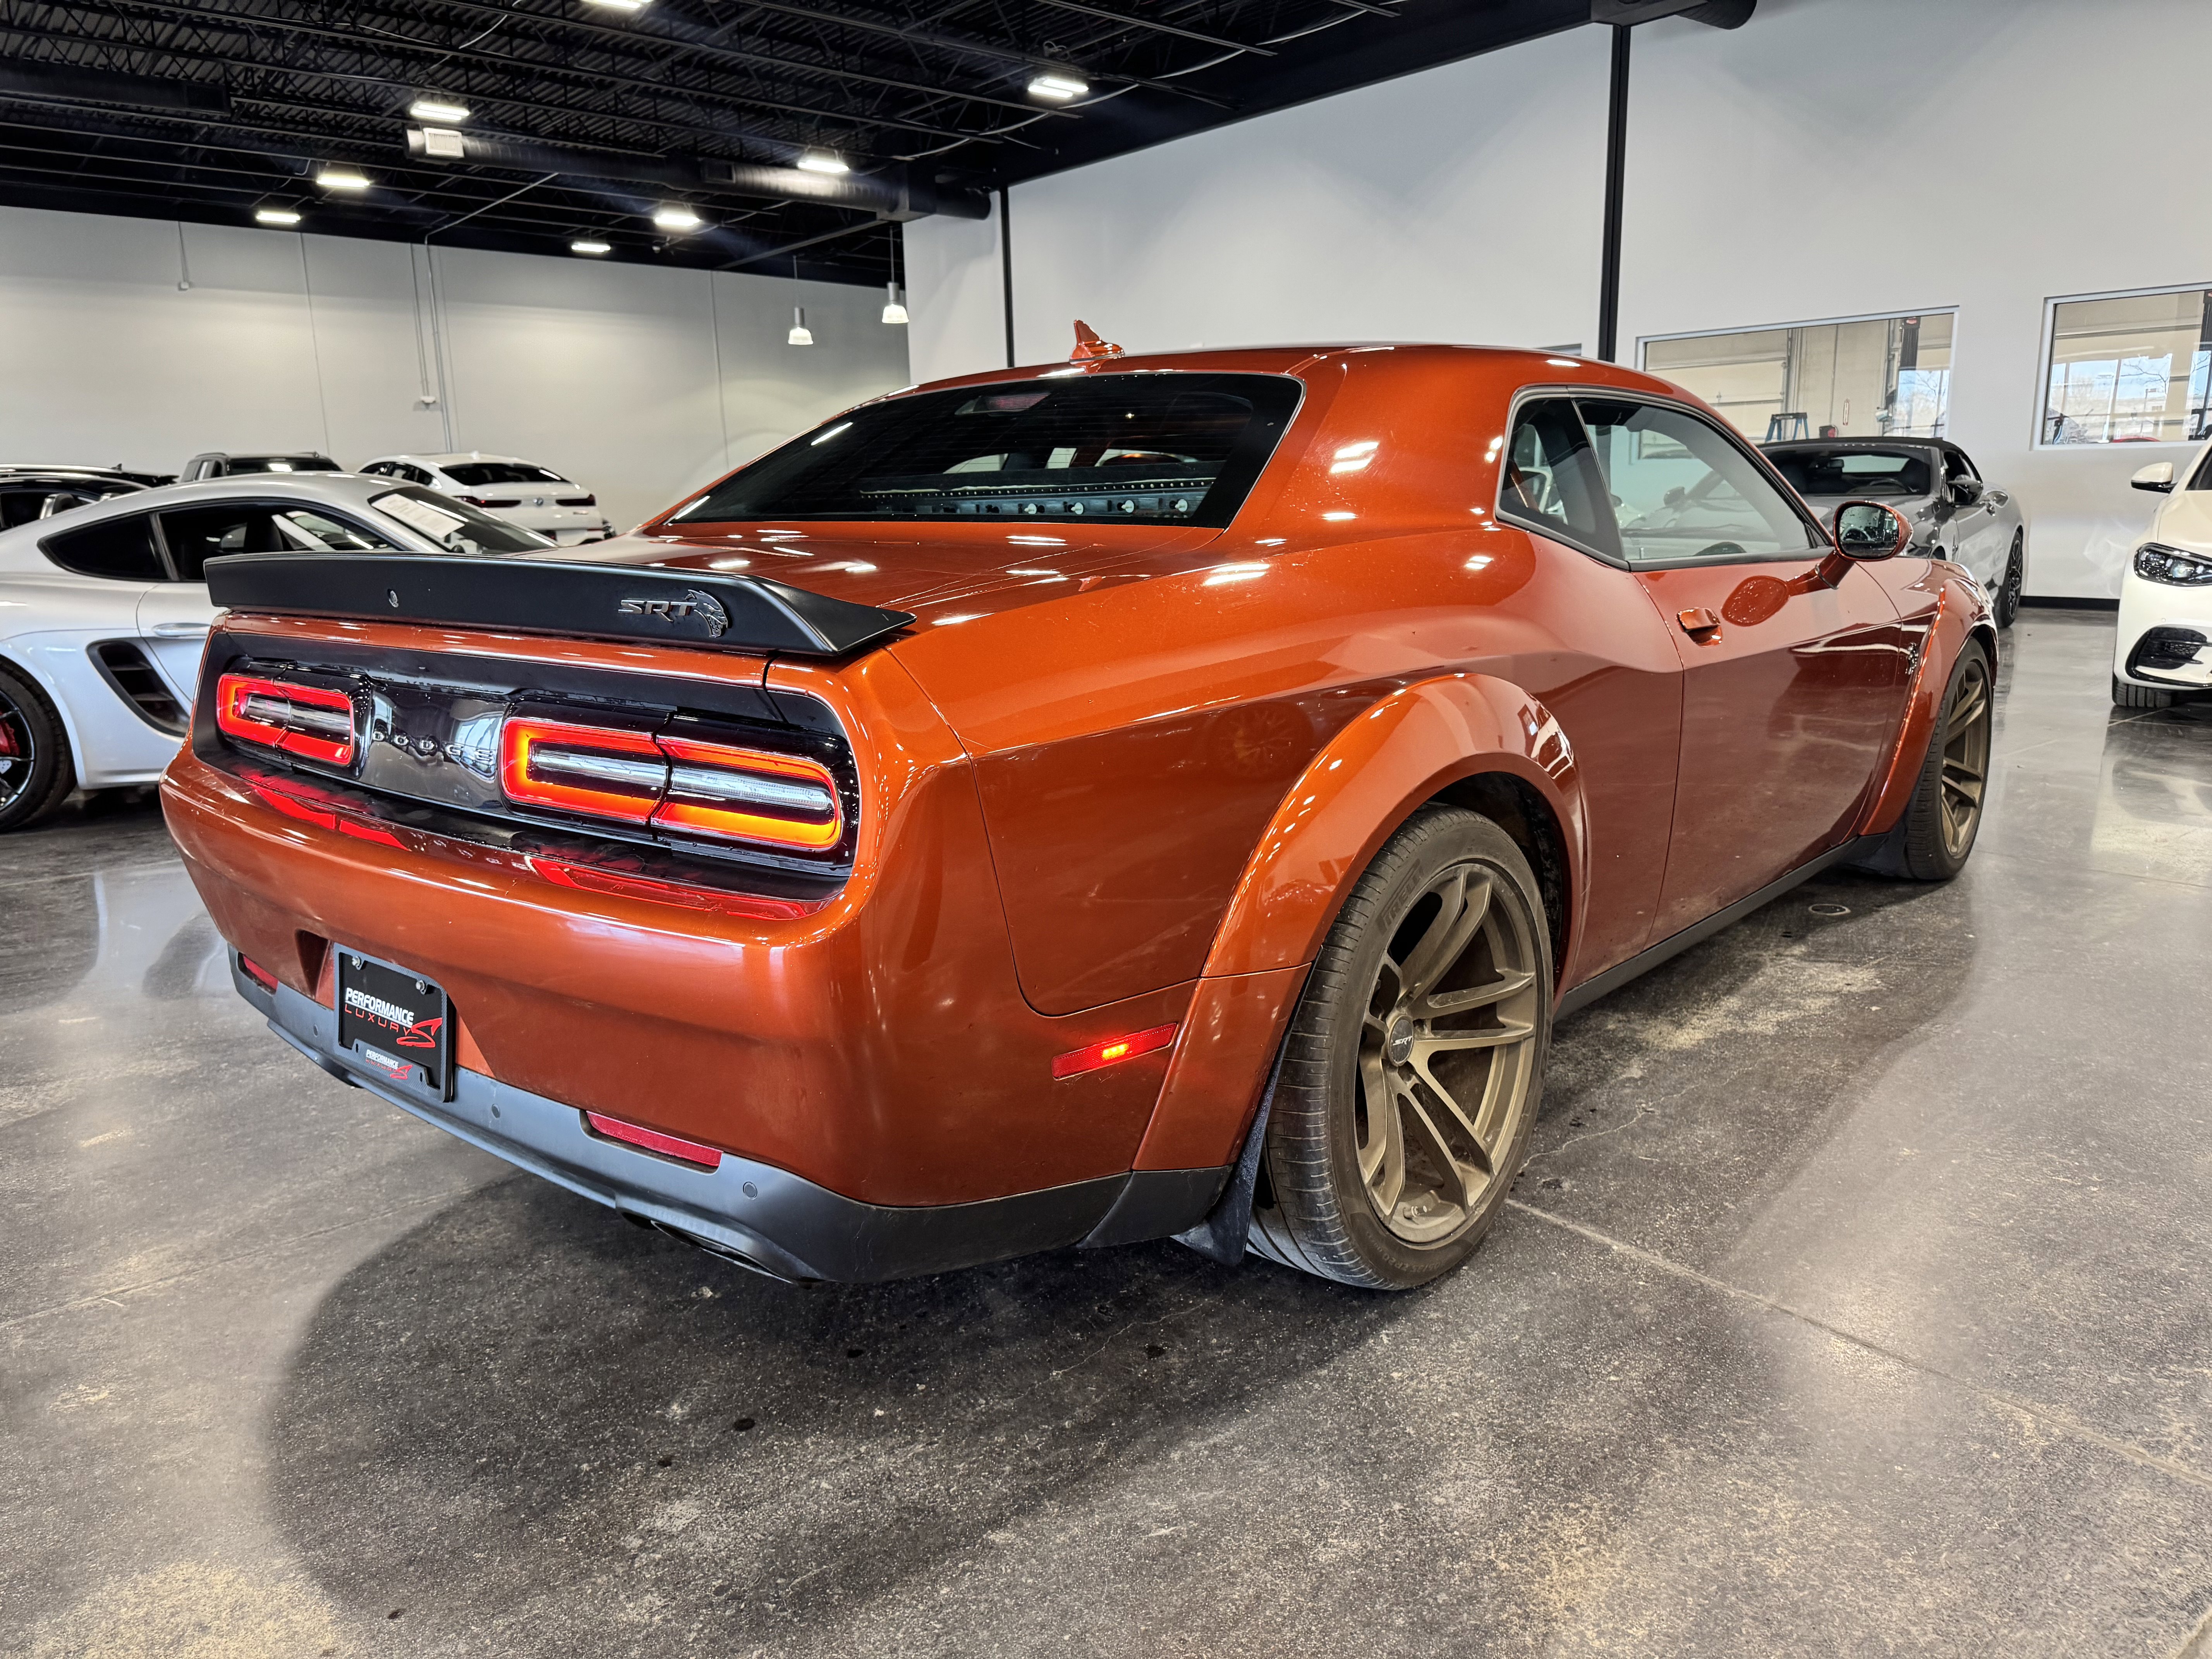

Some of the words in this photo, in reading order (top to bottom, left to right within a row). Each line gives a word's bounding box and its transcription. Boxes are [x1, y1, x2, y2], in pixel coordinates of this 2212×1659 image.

[618, 599, 697, 622] SRT
[372, 731, 494, 762] DODGE
[1375, 858, 1424, 936] PIRELLI
[345, 987, 414, 1025] PERFORMANCE
[345, 1004, 412, 1036] LUXURY
[1393, 1036, 1413, 1046] SRT
[366, 1049, 399, 1068] PERFORMANCE
